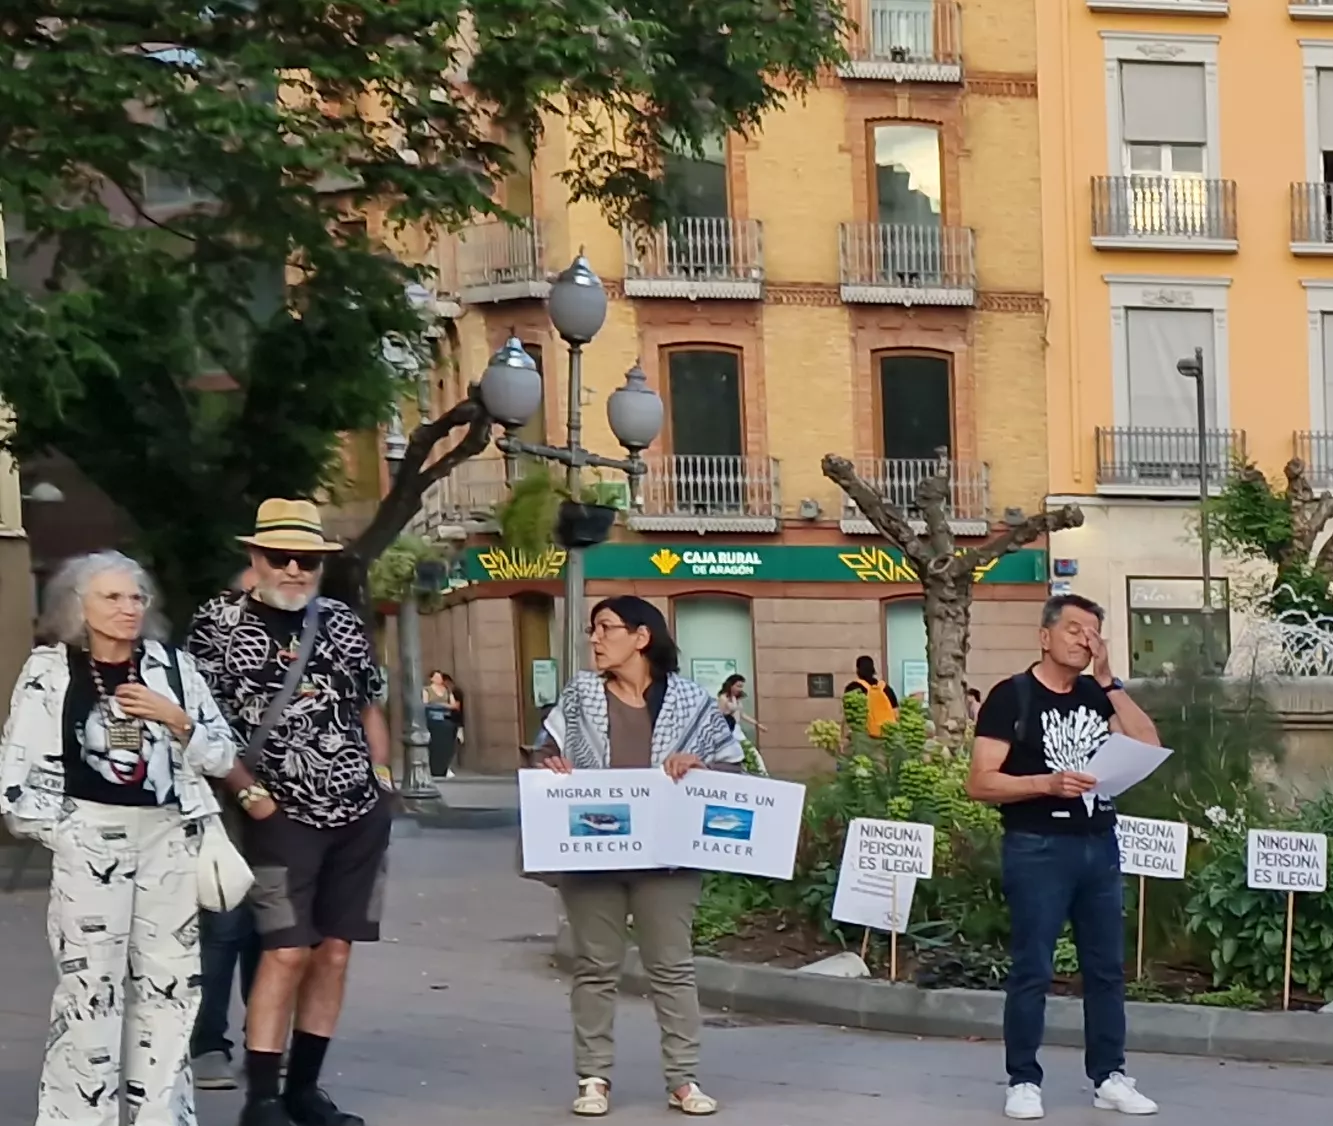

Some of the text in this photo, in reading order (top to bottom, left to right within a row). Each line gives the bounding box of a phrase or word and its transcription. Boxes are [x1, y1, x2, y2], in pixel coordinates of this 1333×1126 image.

[683, 551, 763, 565] CAJA RURAL
[692, 564, 755, 575] DE ARAGÓN
[546, 787, 650, 799] MIGRAR ES UN
[685, 786, 775, 808] VIAJAR ES UN
[860, 823, 923, 842] NINGUNA
[559, 840, 643, 853] DERECHO
[692, 840, 753, 857] PLACER
[859, 840, 923, 858] PERSONA
[1256, 835, 1318, 852] NINGUNA
[858, 856, 927, 875] ES ILEGAL
[1132, 855, 1179, 873] ILEGAL
[1256, 851, 1320, 870] PERSONA
[1254, 868, 1324, 888] ES ILEGAL
